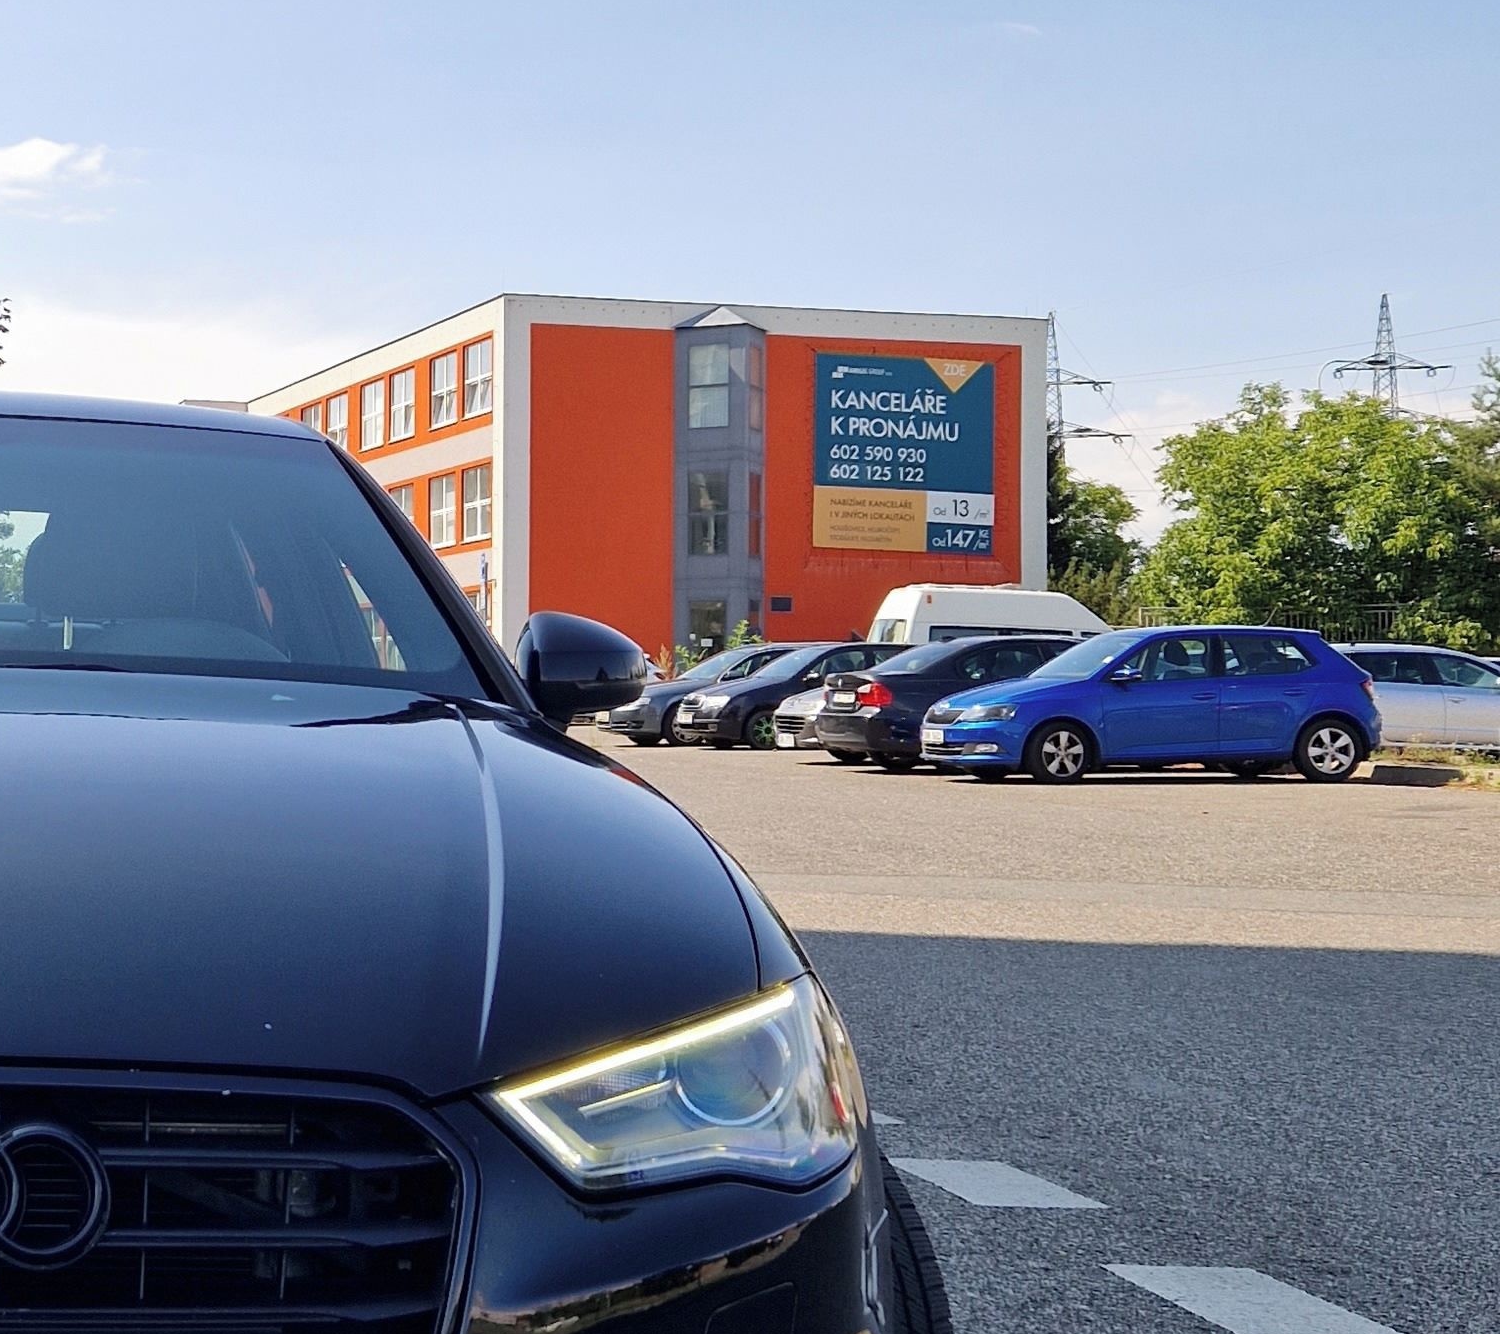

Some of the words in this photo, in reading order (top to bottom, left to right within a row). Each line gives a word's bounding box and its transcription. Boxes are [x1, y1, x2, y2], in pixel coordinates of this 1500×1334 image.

[942, 363, 967, 377] ZDE
[830, 388, 947, 415] KANCELÁŘE
[830, 415, 845, 436] K
[848, 415, 959, 442] PRONÁJMU
[830, 444, 859, 460] 602
[864, 446, 893, 462] 590
[897, 448, 927, 464] 930
[829, 464, 859, 479] 602
[866, 465, 892, 481] 125
[898, 466, 925, 482] 122
[933, 507, 947, 516] Od
[952, 499, 969, 517] 13
[932, 537, 946, 547] Od
[945, 528, 976, 548] 147
